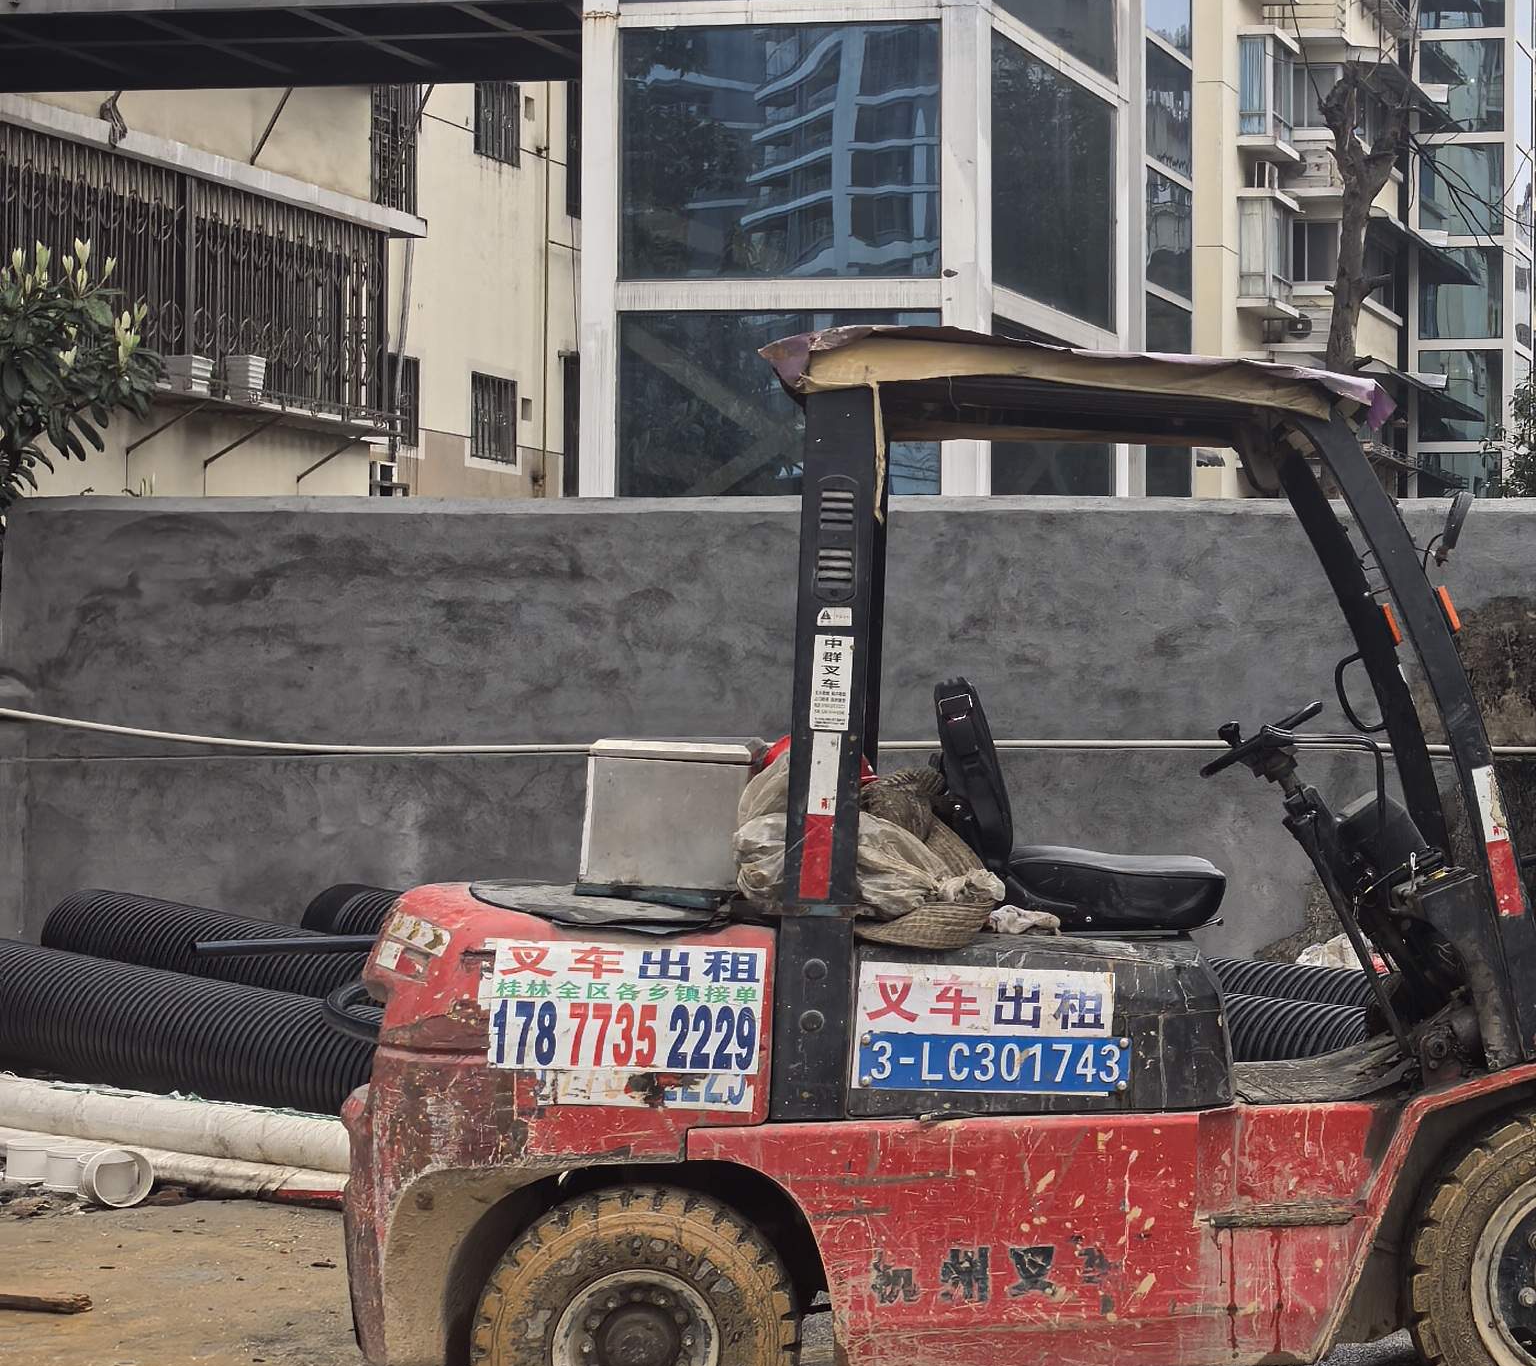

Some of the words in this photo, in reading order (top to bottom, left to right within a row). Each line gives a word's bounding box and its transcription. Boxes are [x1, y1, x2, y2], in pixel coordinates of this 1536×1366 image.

[820, 638, 842, 689] 中群叉车
[499, 946, 760, 984] 叉车出租
[496, 978, 758, 1005] 桂林全区各乡镇接单
[865, 974, 1105, 1030] 叉车出租
[493, 999, 558, 1066] 178
[569, 1002, 658, 1068] 7735
[666, 1004, 757, 1071] 2229
[870, 1040, 1121, 1084] 3-LC301743
